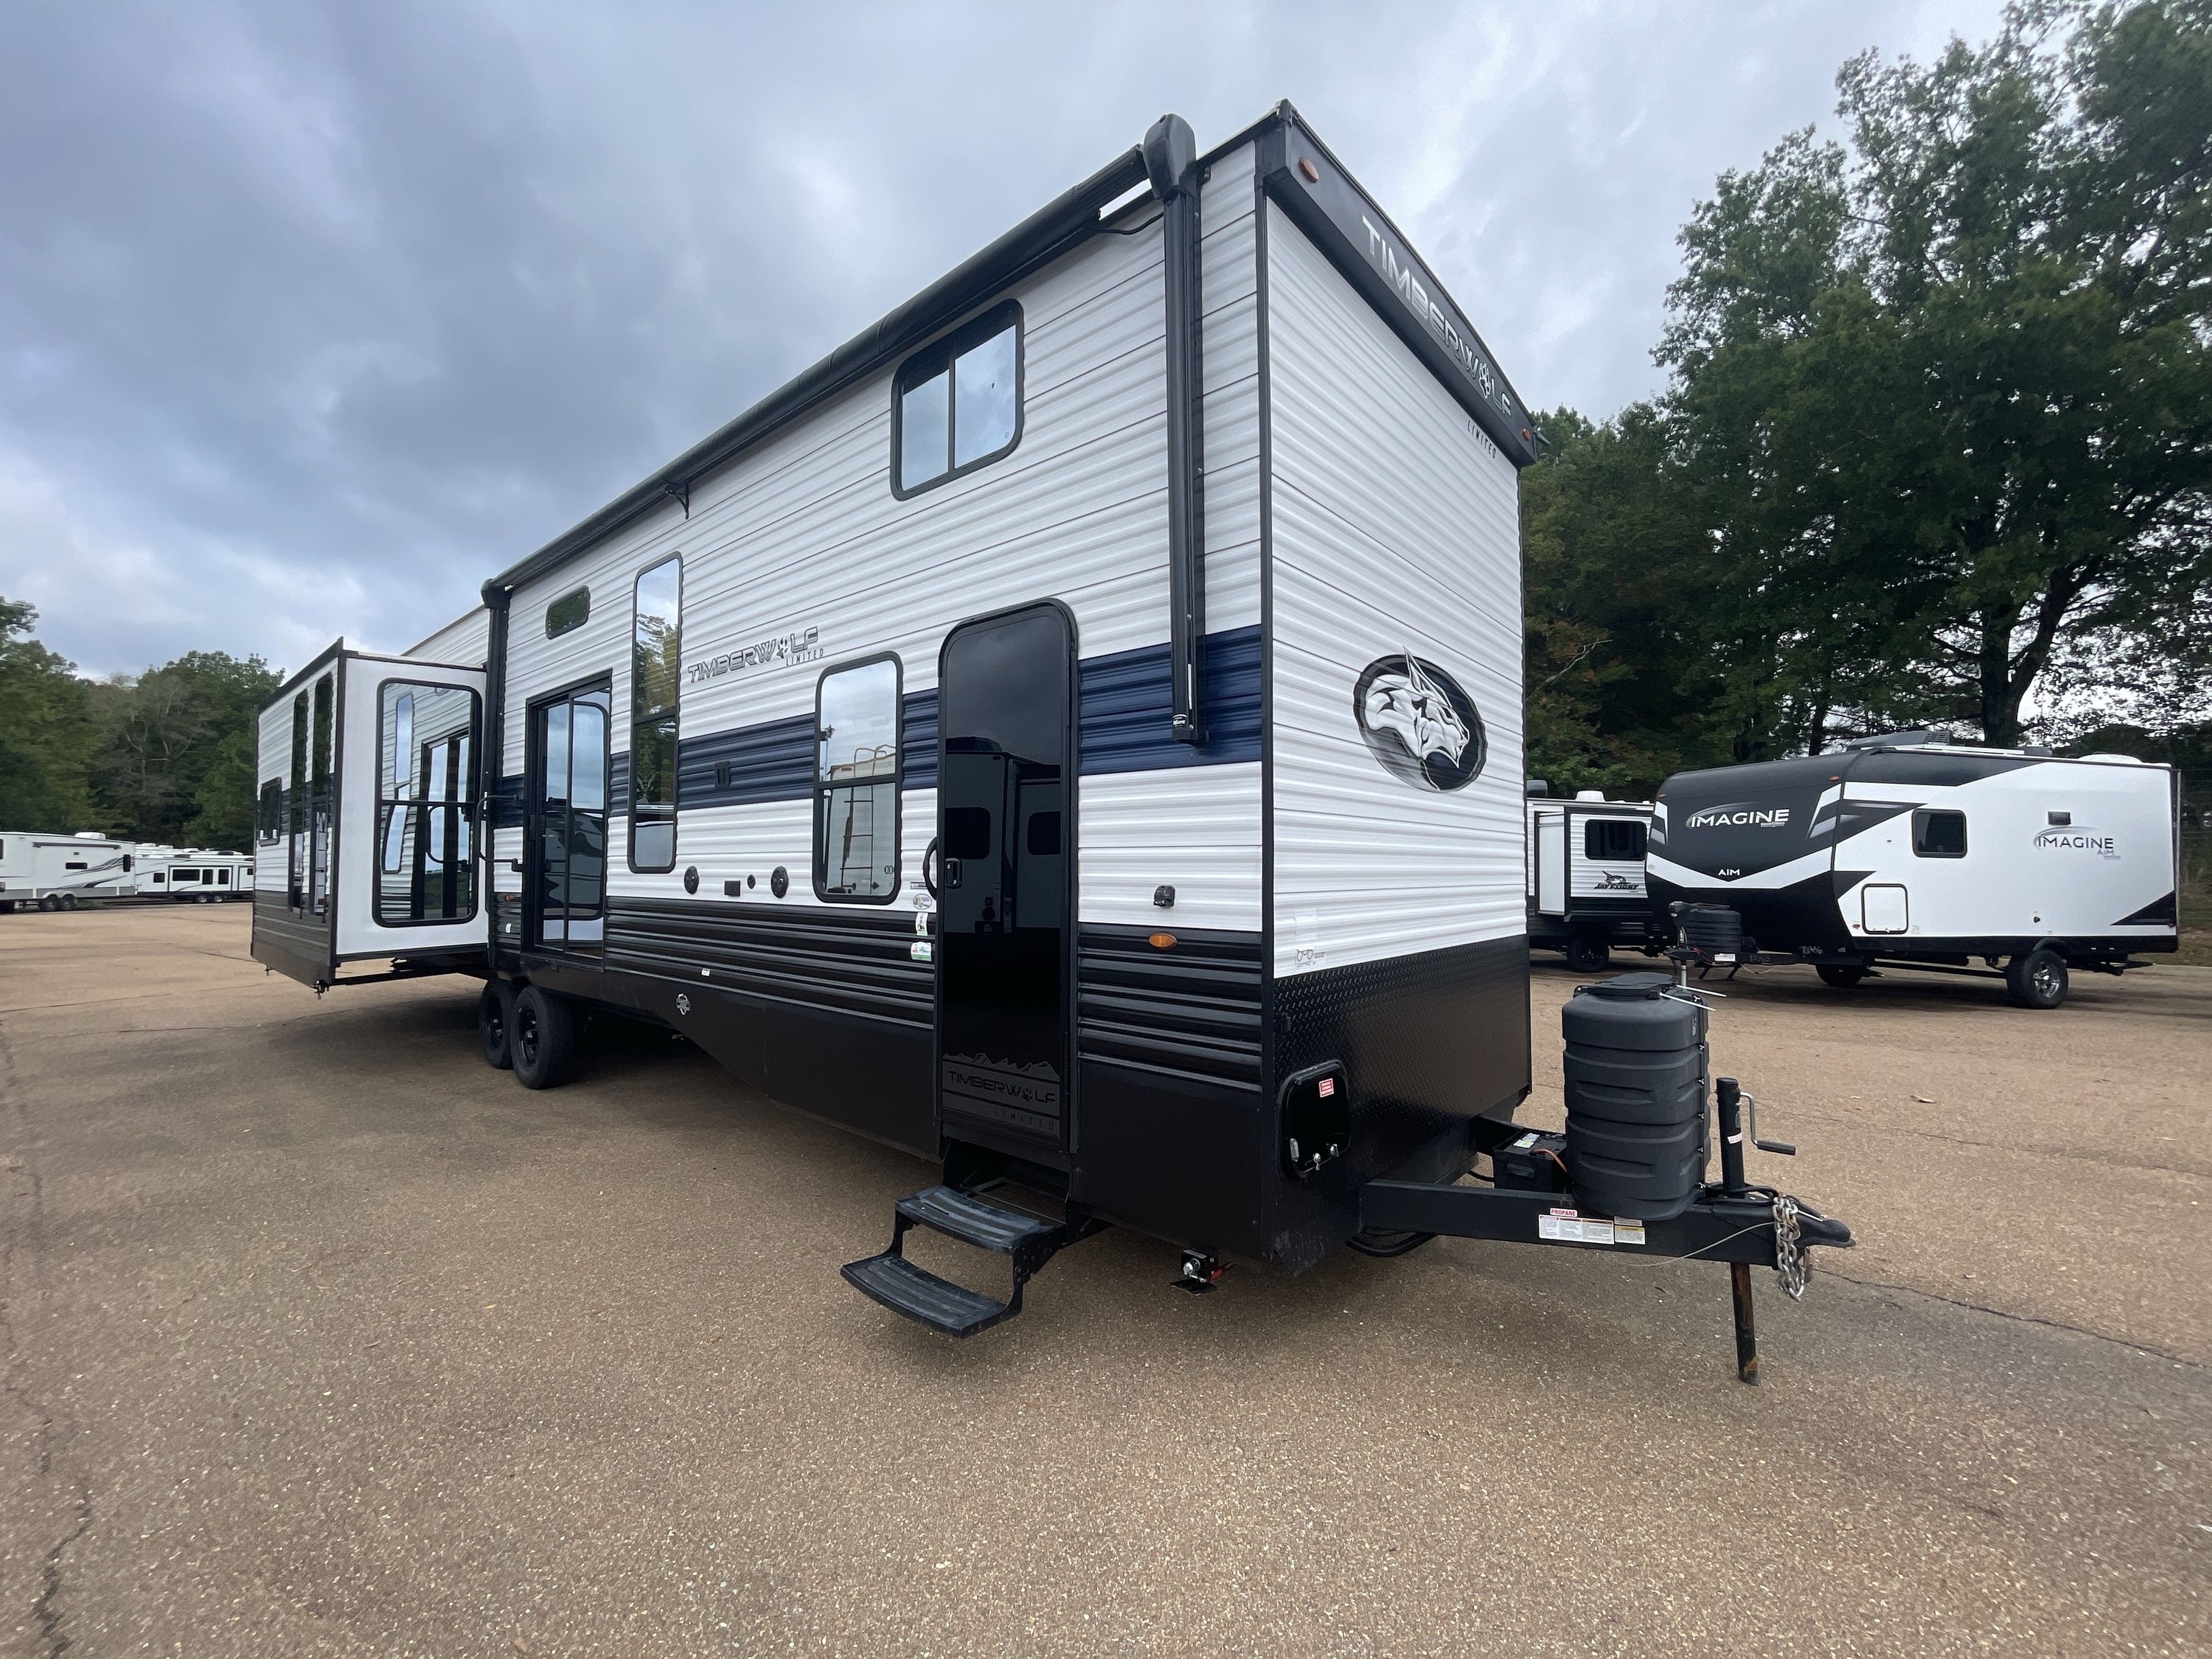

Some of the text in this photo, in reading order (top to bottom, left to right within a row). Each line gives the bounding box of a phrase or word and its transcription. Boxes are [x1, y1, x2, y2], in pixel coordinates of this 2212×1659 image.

[1467, 420, 1497, 459] LIMITED
[785, 648, 824, 666] LIMITED
[1691, 809, 1790, 827] IMAGINE
[2038, 836, 2114, 849] IMAGINE
[993, 1107, 1054, 1130] LIMITED
